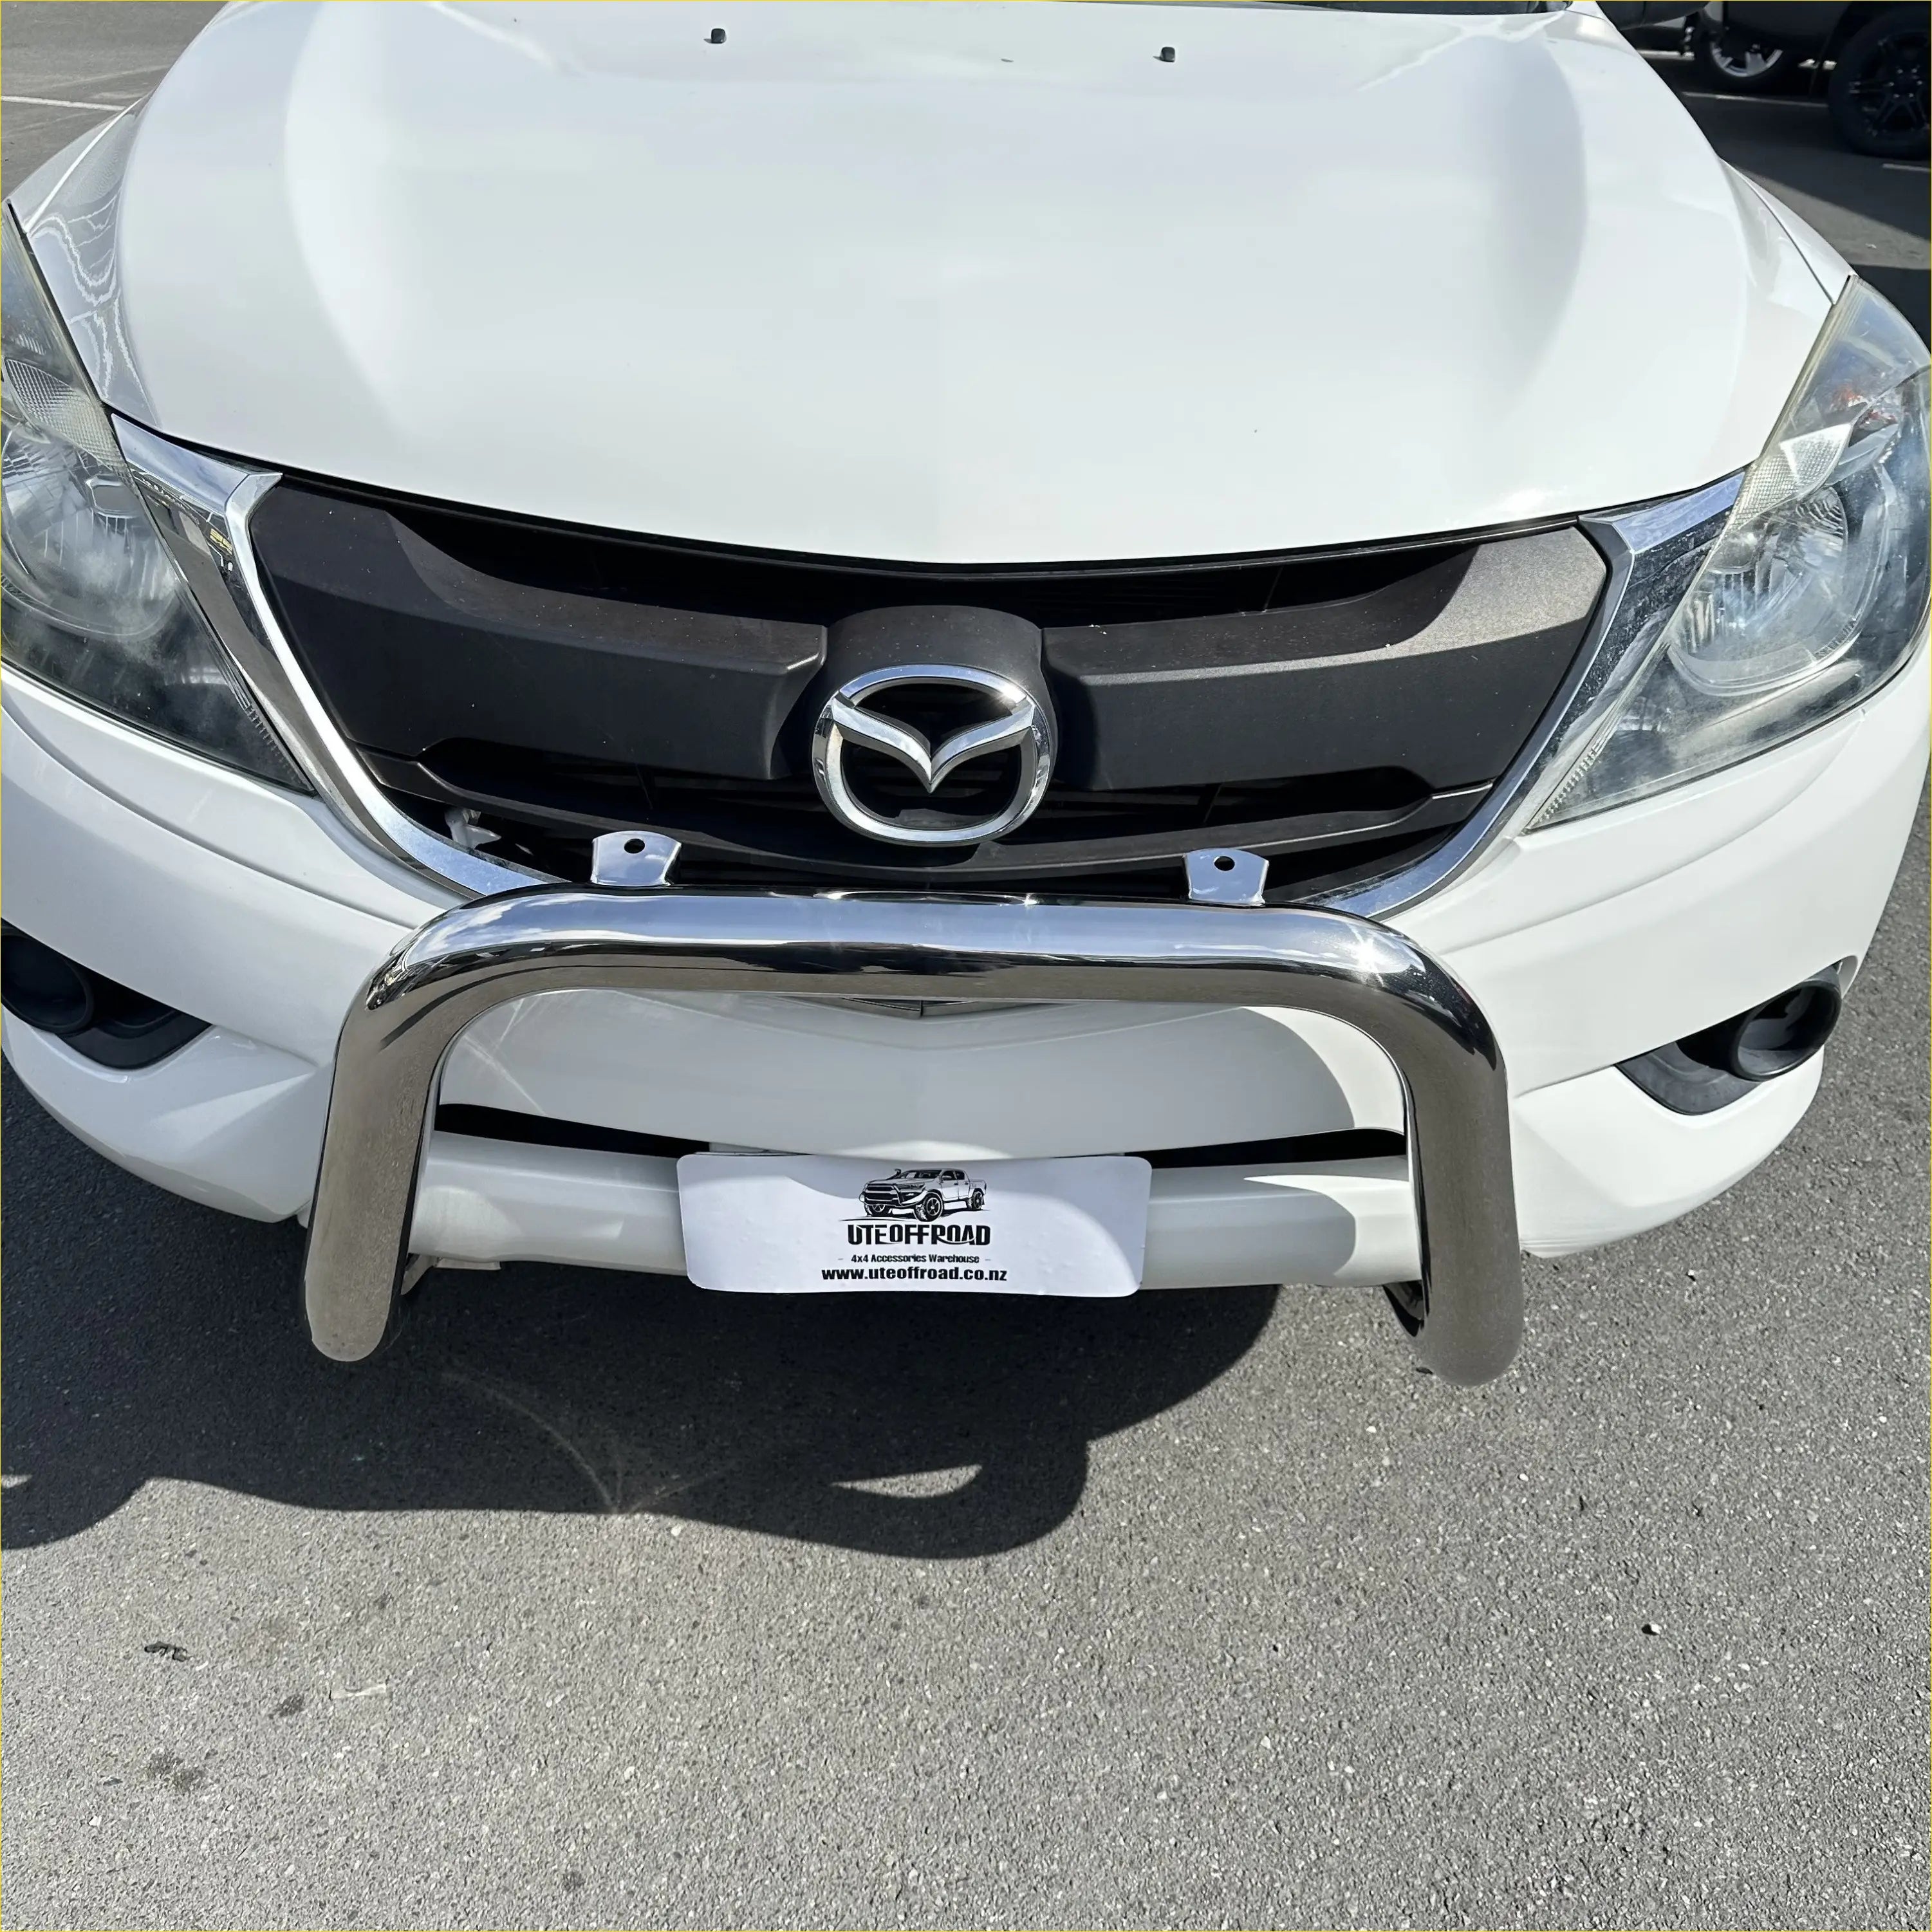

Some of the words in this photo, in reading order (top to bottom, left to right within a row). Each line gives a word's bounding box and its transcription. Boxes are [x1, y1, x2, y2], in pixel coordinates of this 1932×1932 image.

[851, 1254, 869, 1263] 4x4
[871, 1254, 927, 1263] Accessories
[928, 1254, 980, 1263] Warehouse
[821, 1267, 1007, 1281] www.uteoffroad.co.nz
